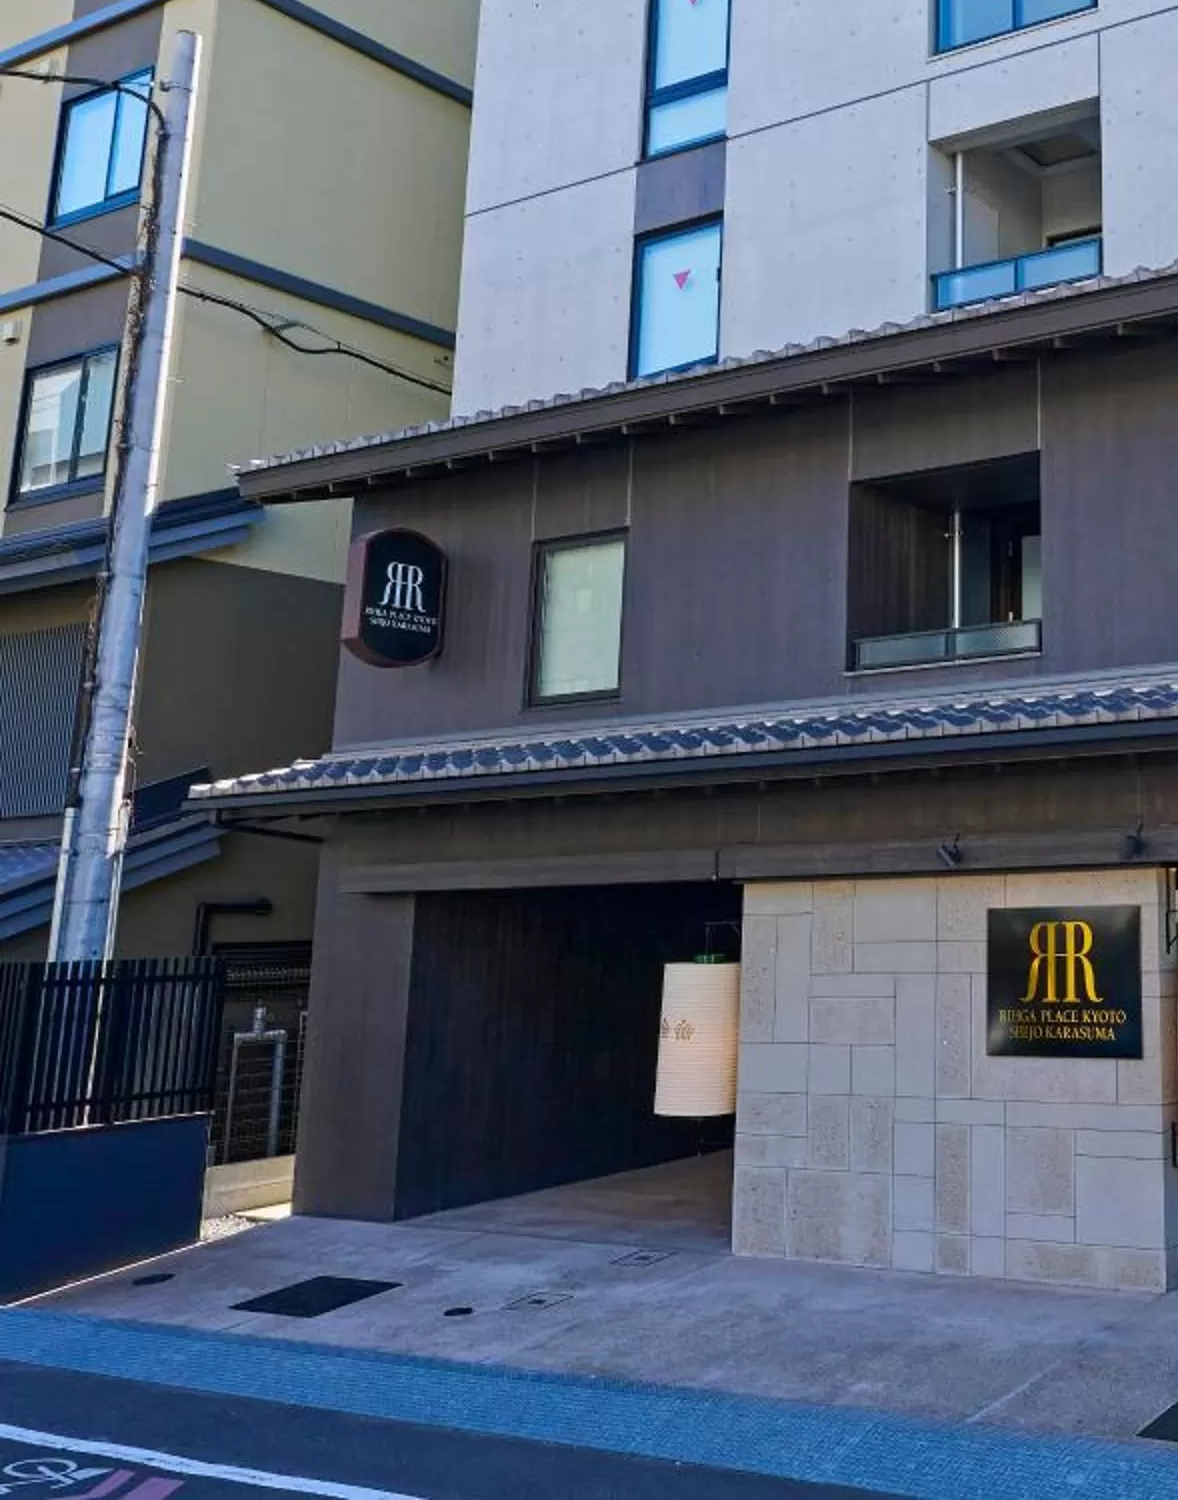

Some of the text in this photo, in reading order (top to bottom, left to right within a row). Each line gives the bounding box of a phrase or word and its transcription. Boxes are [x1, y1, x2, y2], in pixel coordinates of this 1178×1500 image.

[1041, 1009, 1078, 1023] PLACE
[1083, 1009, 1127, 1024] KYOTO
[1045, 1026, 1116, 1041] KARASUMA
